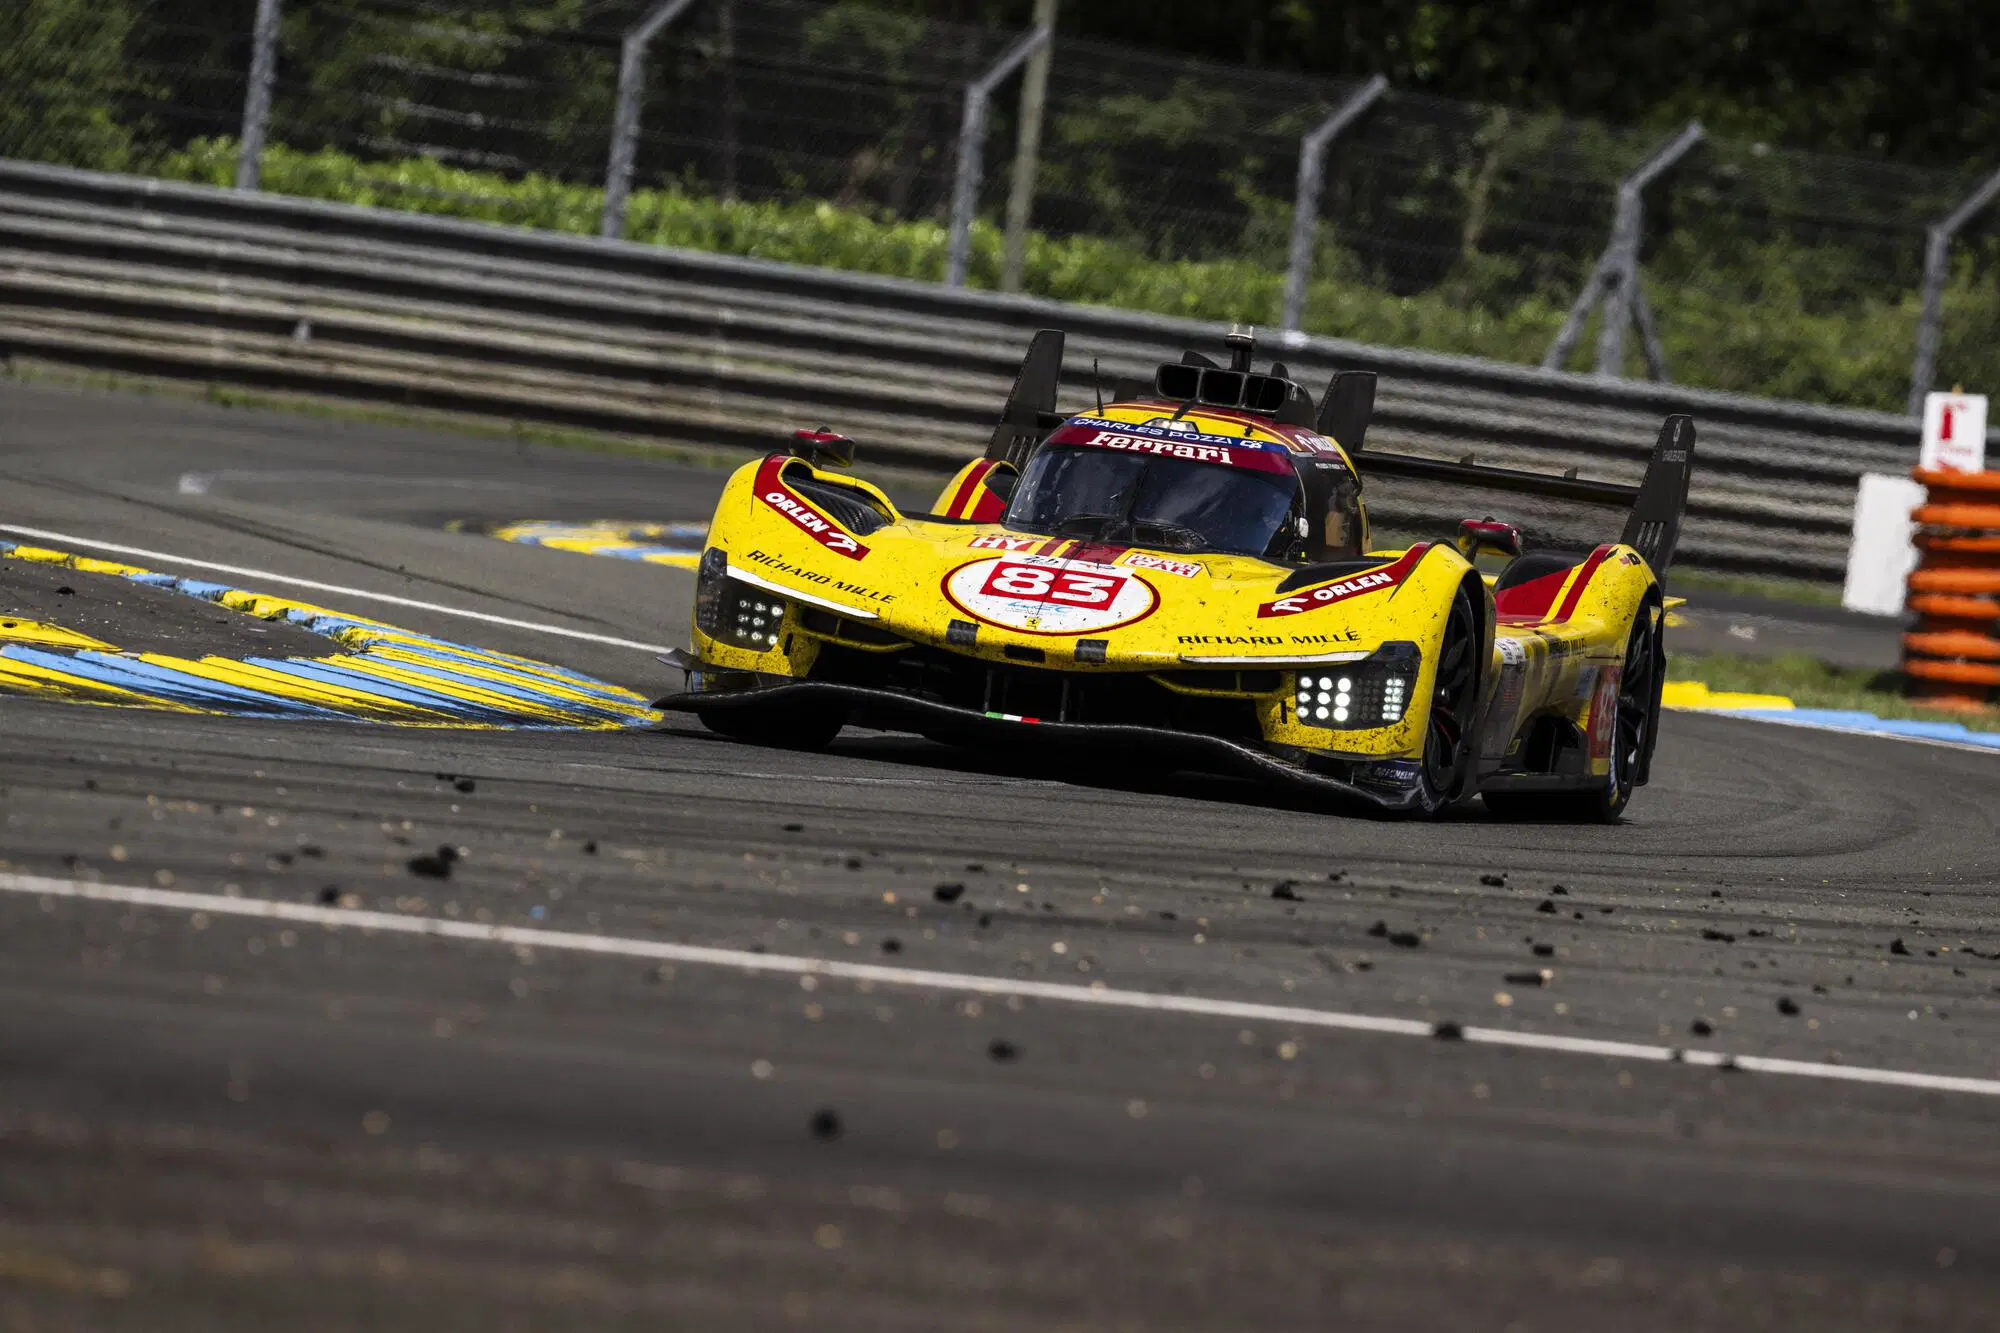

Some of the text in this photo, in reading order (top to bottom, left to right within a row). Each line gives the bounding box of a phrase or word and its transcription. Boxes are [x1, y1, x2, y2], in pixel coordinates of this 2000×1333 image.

[1073, 418, 1163, 436] CHARLES
[1168, 430, 1233, 444] POZZI
[1085, 430, 1233, 465] Ferrari
[765, 492, 830, 532] ORLEN
[746, 550, 897, 604] RICHARD MILLE
[1130, 559, 1192, 576] CAR
[991, 566, 1117, 603] 83
[1313, 572, 1393, 601] ORLEN
[1177, 630, 1362, 645] RICHARD MILLE
